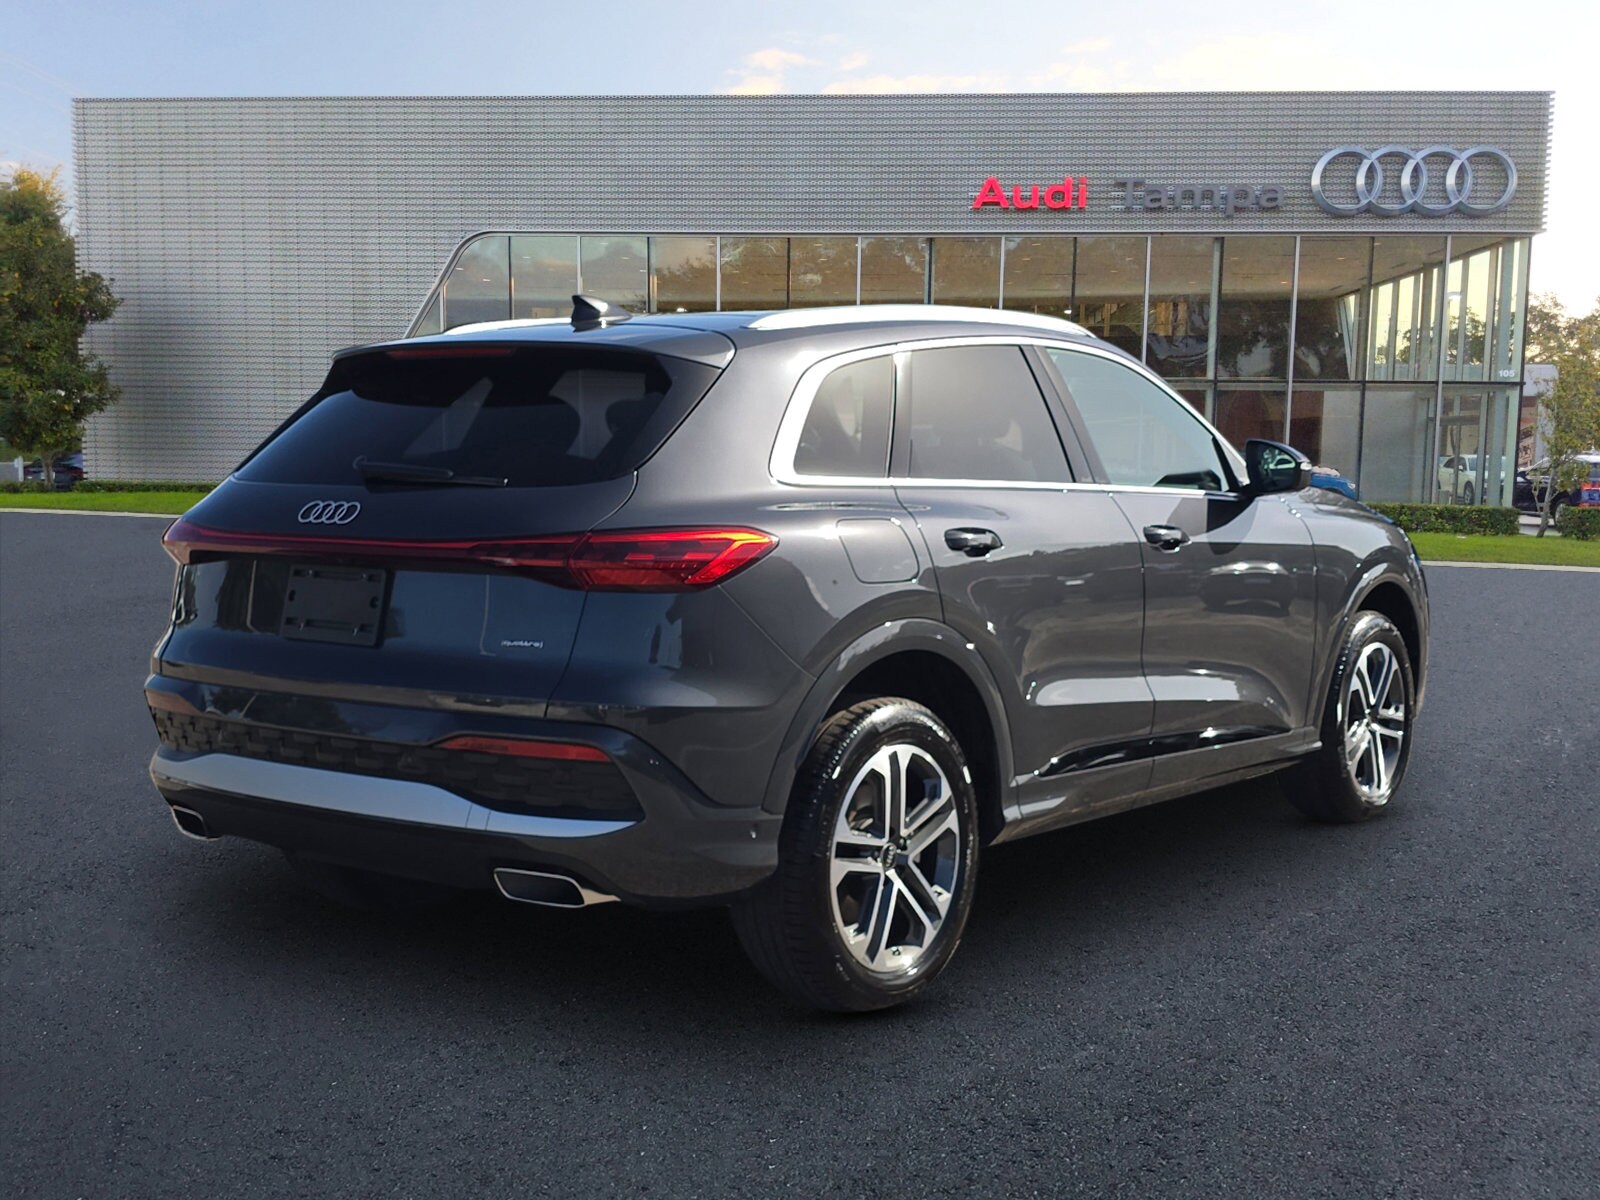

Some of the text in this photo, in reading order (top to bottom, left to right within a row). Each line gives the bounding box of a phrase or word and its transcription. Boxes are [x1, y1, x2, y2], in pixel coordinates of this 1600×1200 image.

[972, 176, 1286, 218] Audi Tampa
[1499, 369, 1515, 378] 105
